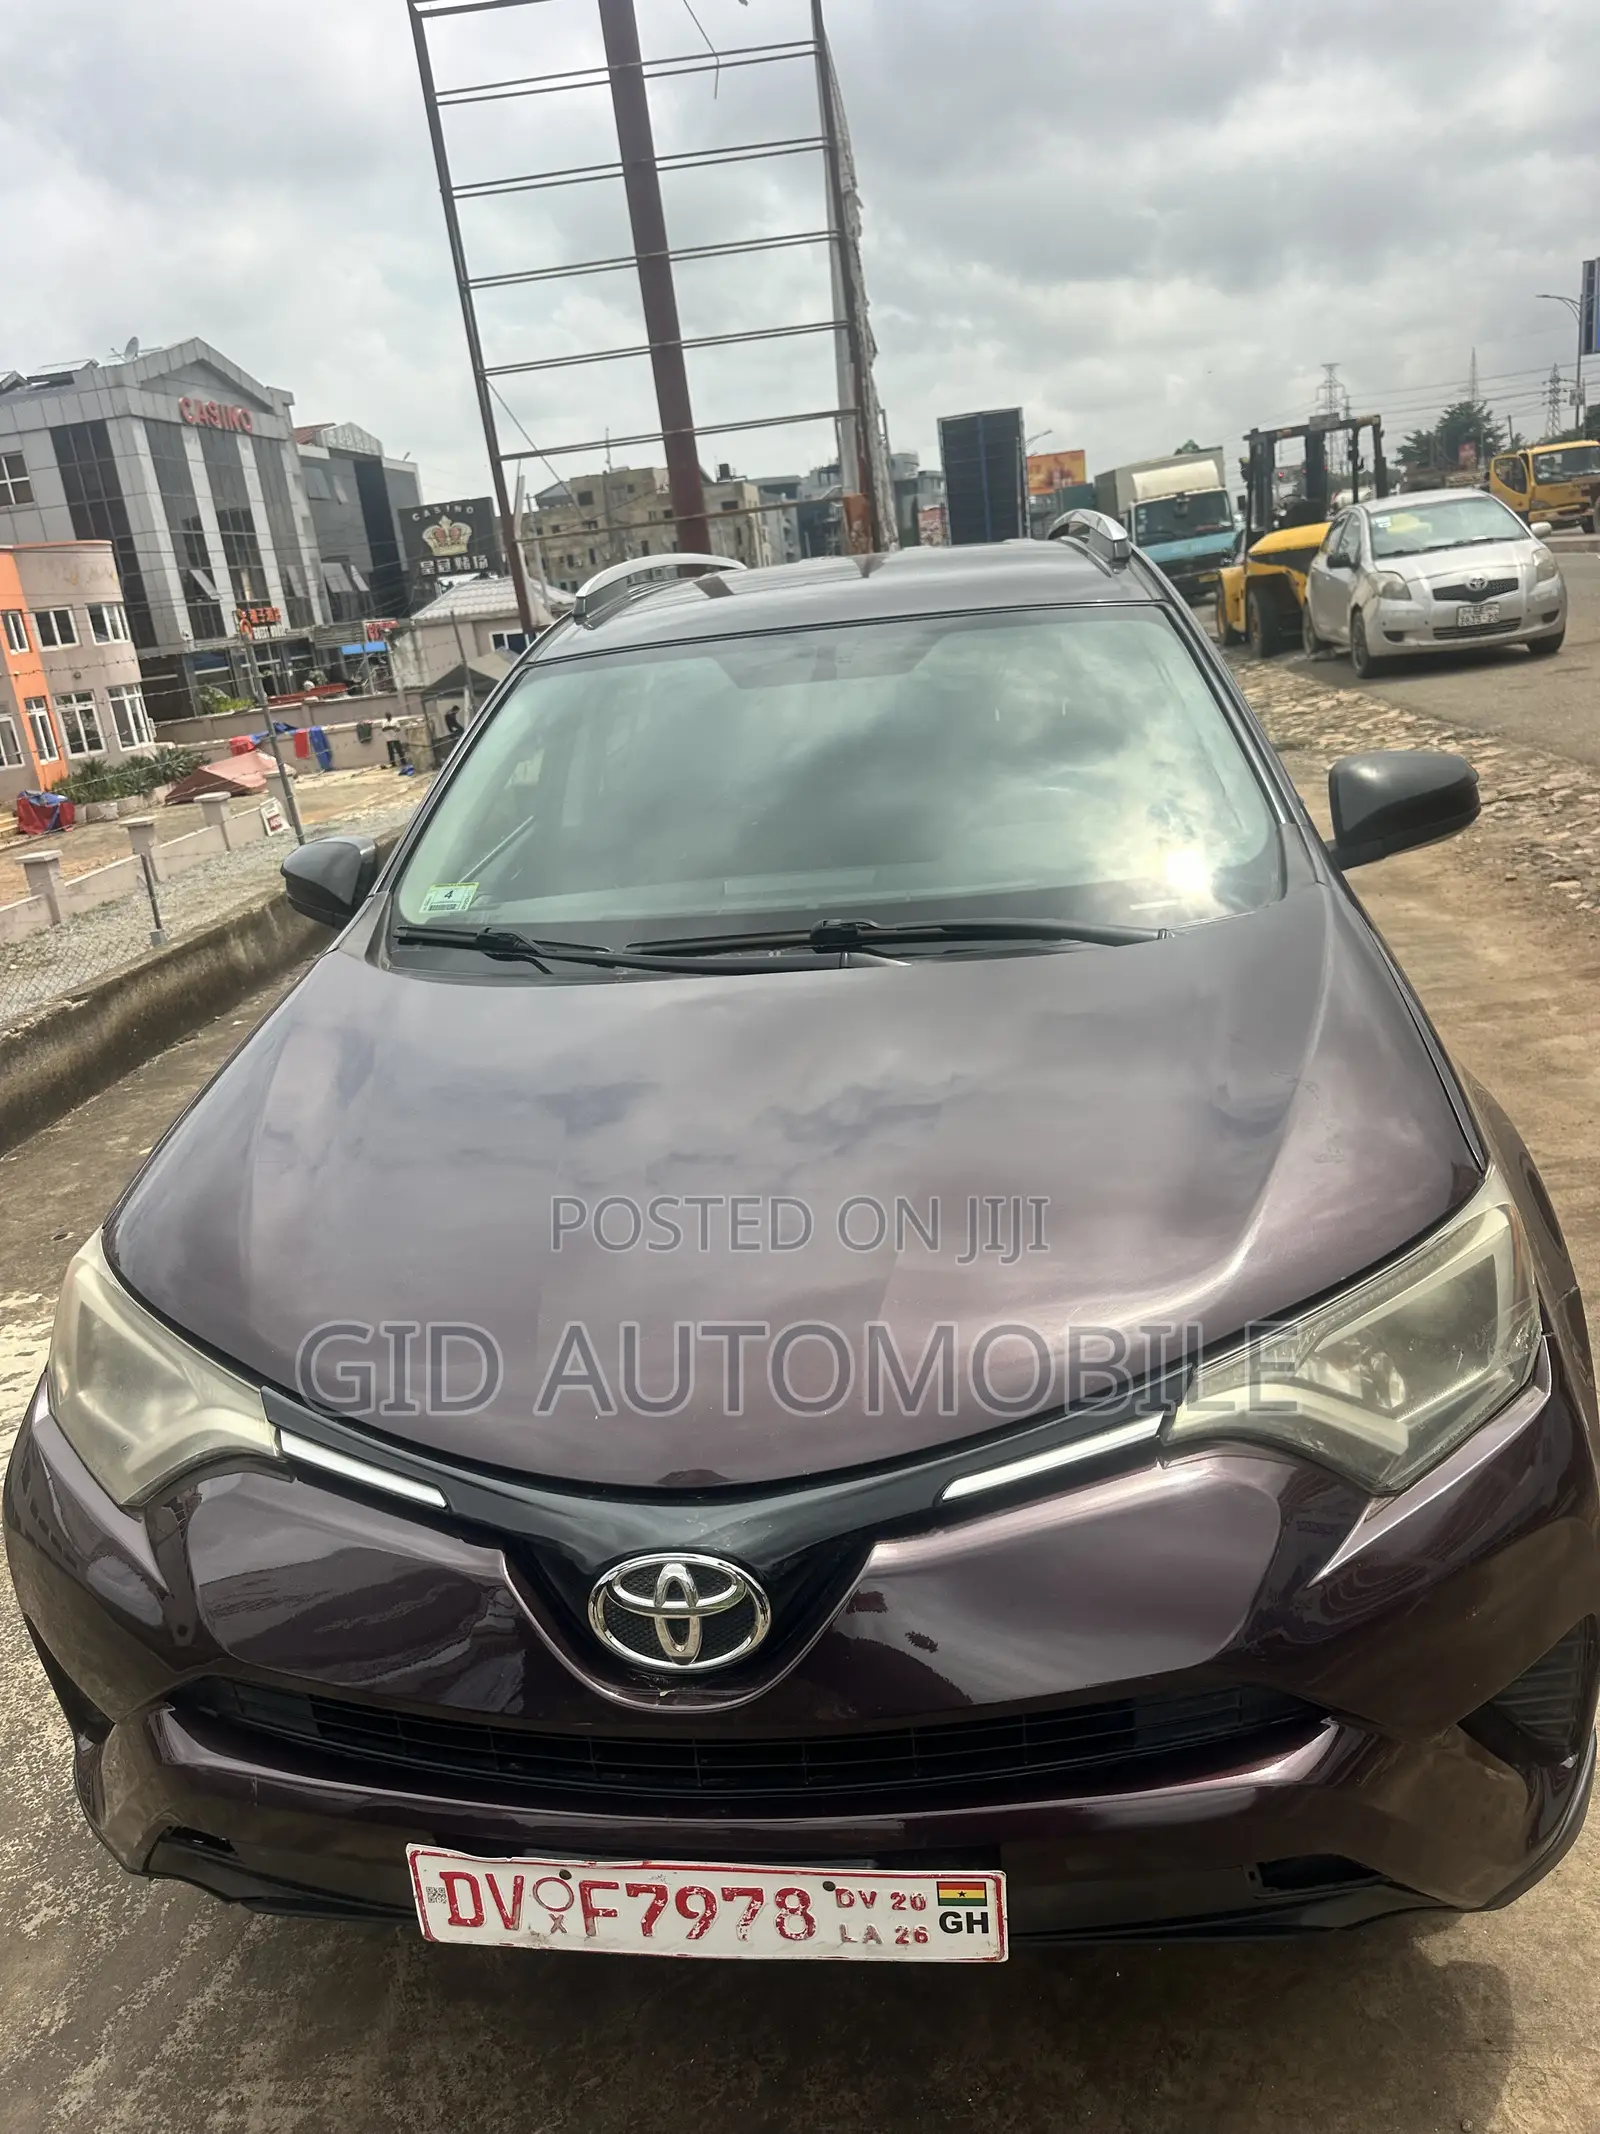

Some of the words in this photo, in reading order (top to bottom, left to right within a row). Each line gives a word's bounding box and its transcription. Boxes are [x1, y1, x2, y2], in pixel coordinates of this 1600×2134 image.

[178, 397, 253, 434] CASINO
[412, 504, 475, 521] CASINO
[444, 890, 454, 899] 4
[439, 1871, 525, 1931] DV
[578, 1879, 817, 1941] F7978
[835, 1888, 878, 1909] DV
[890, 1892, 927, 1911] 20
[839, 1924, 883, 1945] LA
[895, 1924, 930, 1945] 26
[938, 1911, 989, 1935] GH
